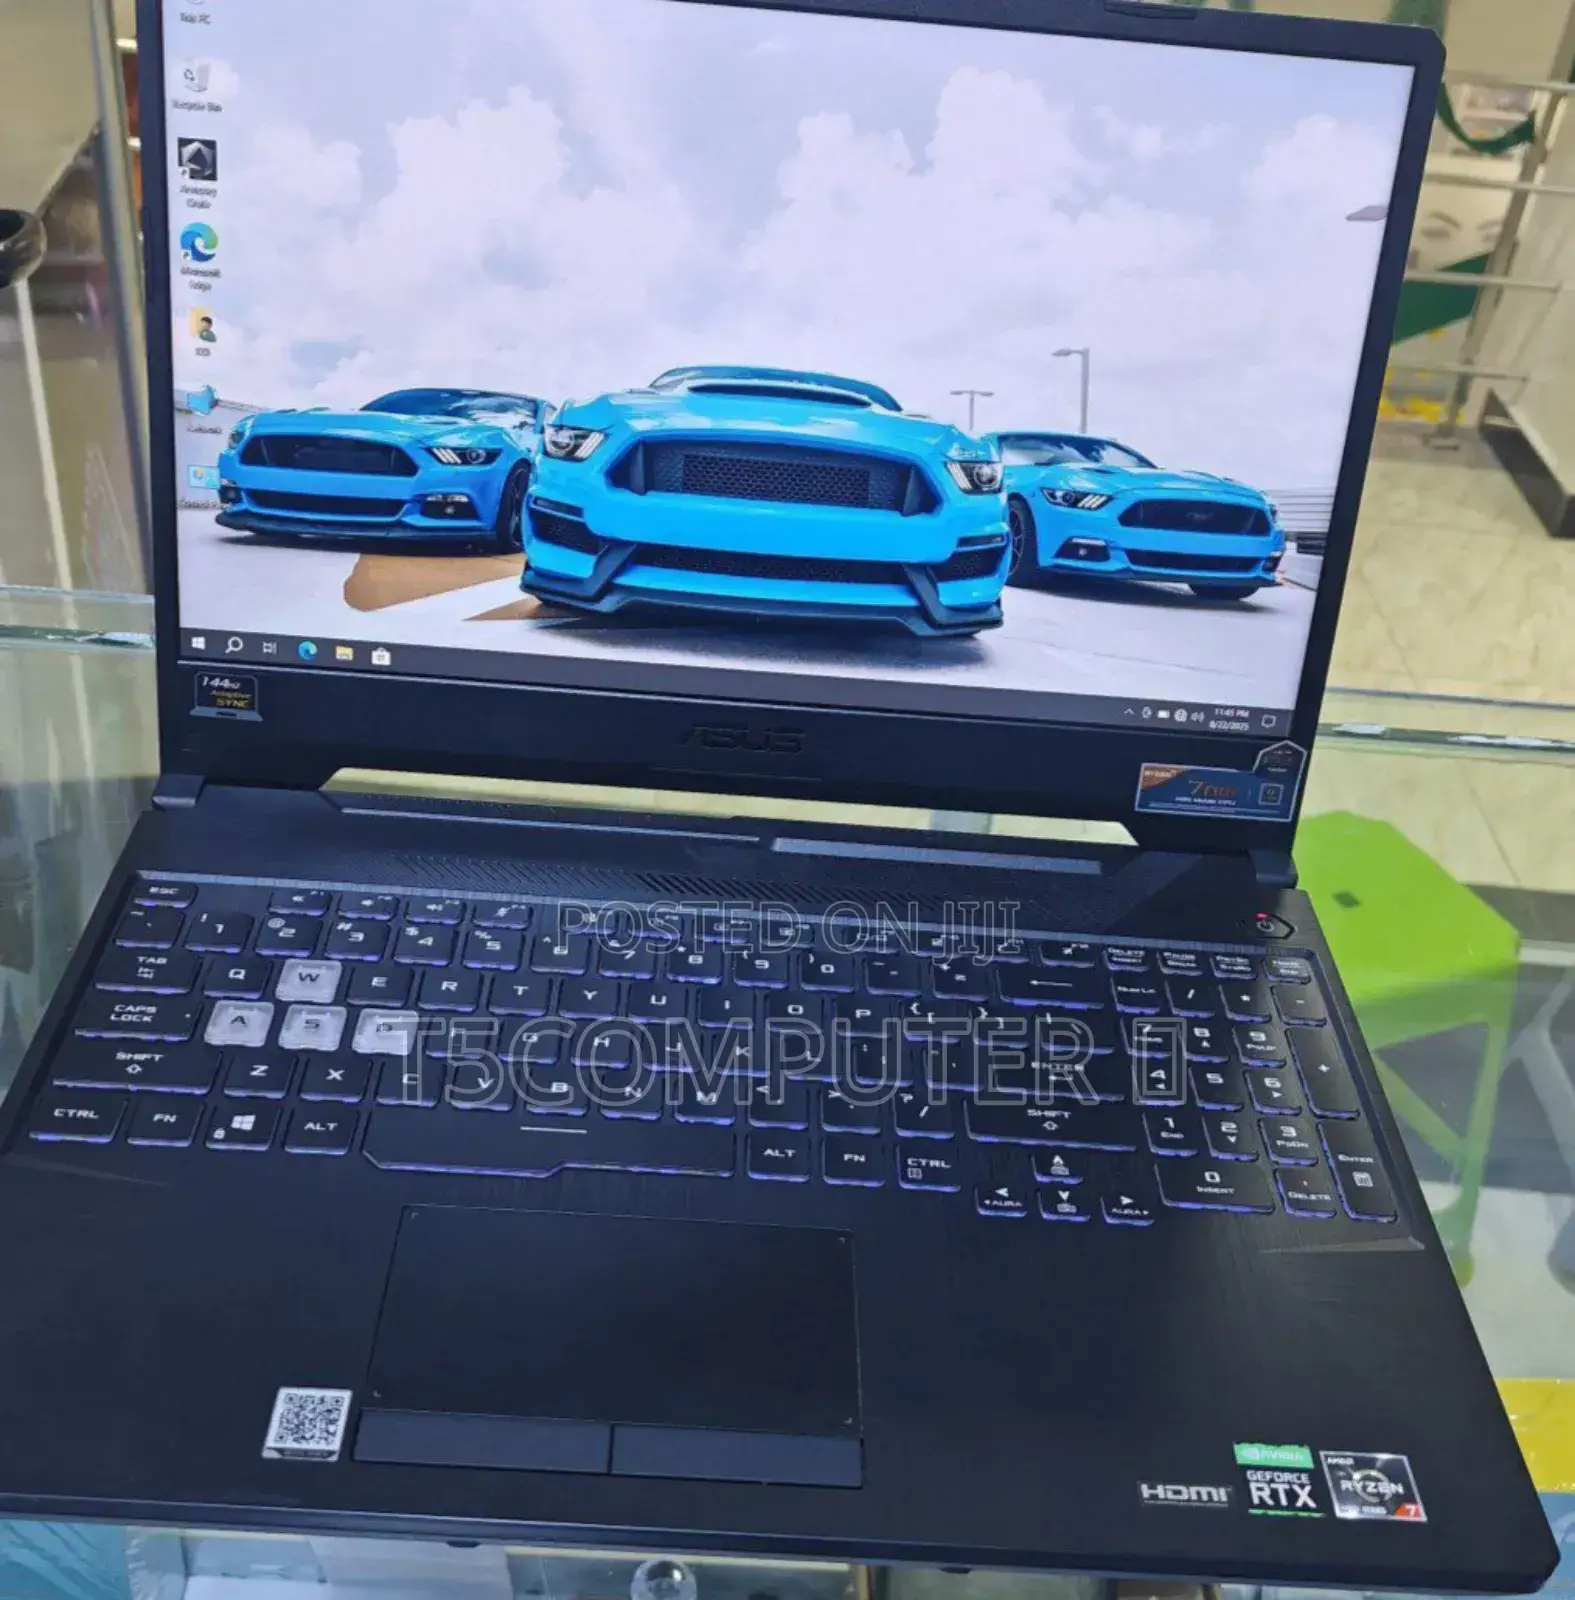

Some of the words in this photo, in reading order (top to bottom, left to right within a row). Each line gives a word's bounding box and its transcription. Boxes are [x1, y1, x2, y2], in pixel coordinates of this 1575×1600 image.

[278, 928, 296, 938] 2
[348, 932, 365, 942] 3
[417, 937, 434, 947] 4
[137, 956, 167, 964] TAB
[688, 954, 703, 964] 8
[754, 960, 769, 970] 9
[228, 969, 246, 980] Q
[298, 971, 320, 982] W
[371, 976, 388, 987] E
[441, 981, 458, 991] R
[513, 986, 529, 996] T
[583, 990, 598, 1000] Y
[650, 995, 667, 1005] U
[114, 1004, 157, 1013] CAPS
[110, 1013, 153, 1022] LOCK
[855, 1009, 871, 1019] P
[231, 1015, 247, 1026] A
[304, 1019, 320, 1029] S
[593, 1036, 610, 1047] H
[115, 1051, 164, 1062] SHIFT
[250, 1065, 269, 1076] Z
[325, 1068, 345, 1080] X
[1150, 1069, 1166, 1080] 4
[477, 1078, 495, 1089] V
[551, 1082, 568, 1093] B
[696, 1091, 717, 1103] M
[54, 1108, 99, 1118] CTRL
[153, 1113, 177, 1123] FN
[1027, 1108, 1072, 1119] SHIFT
[304, 1121, 339, 1131] ALT
[763, 1148, 796, 1158] ALT
[843, 1153, 866, 1163] FN
[907, 1158, 952, 1168] CTRL
[1246, 1469, 1310, 1484] GEFORCE
[1340, 1479, 1405, 1495] RYZEN
[1249, 1481, 1318, 1509] RTX
[1405, 1504, 1416, 1516] 7
